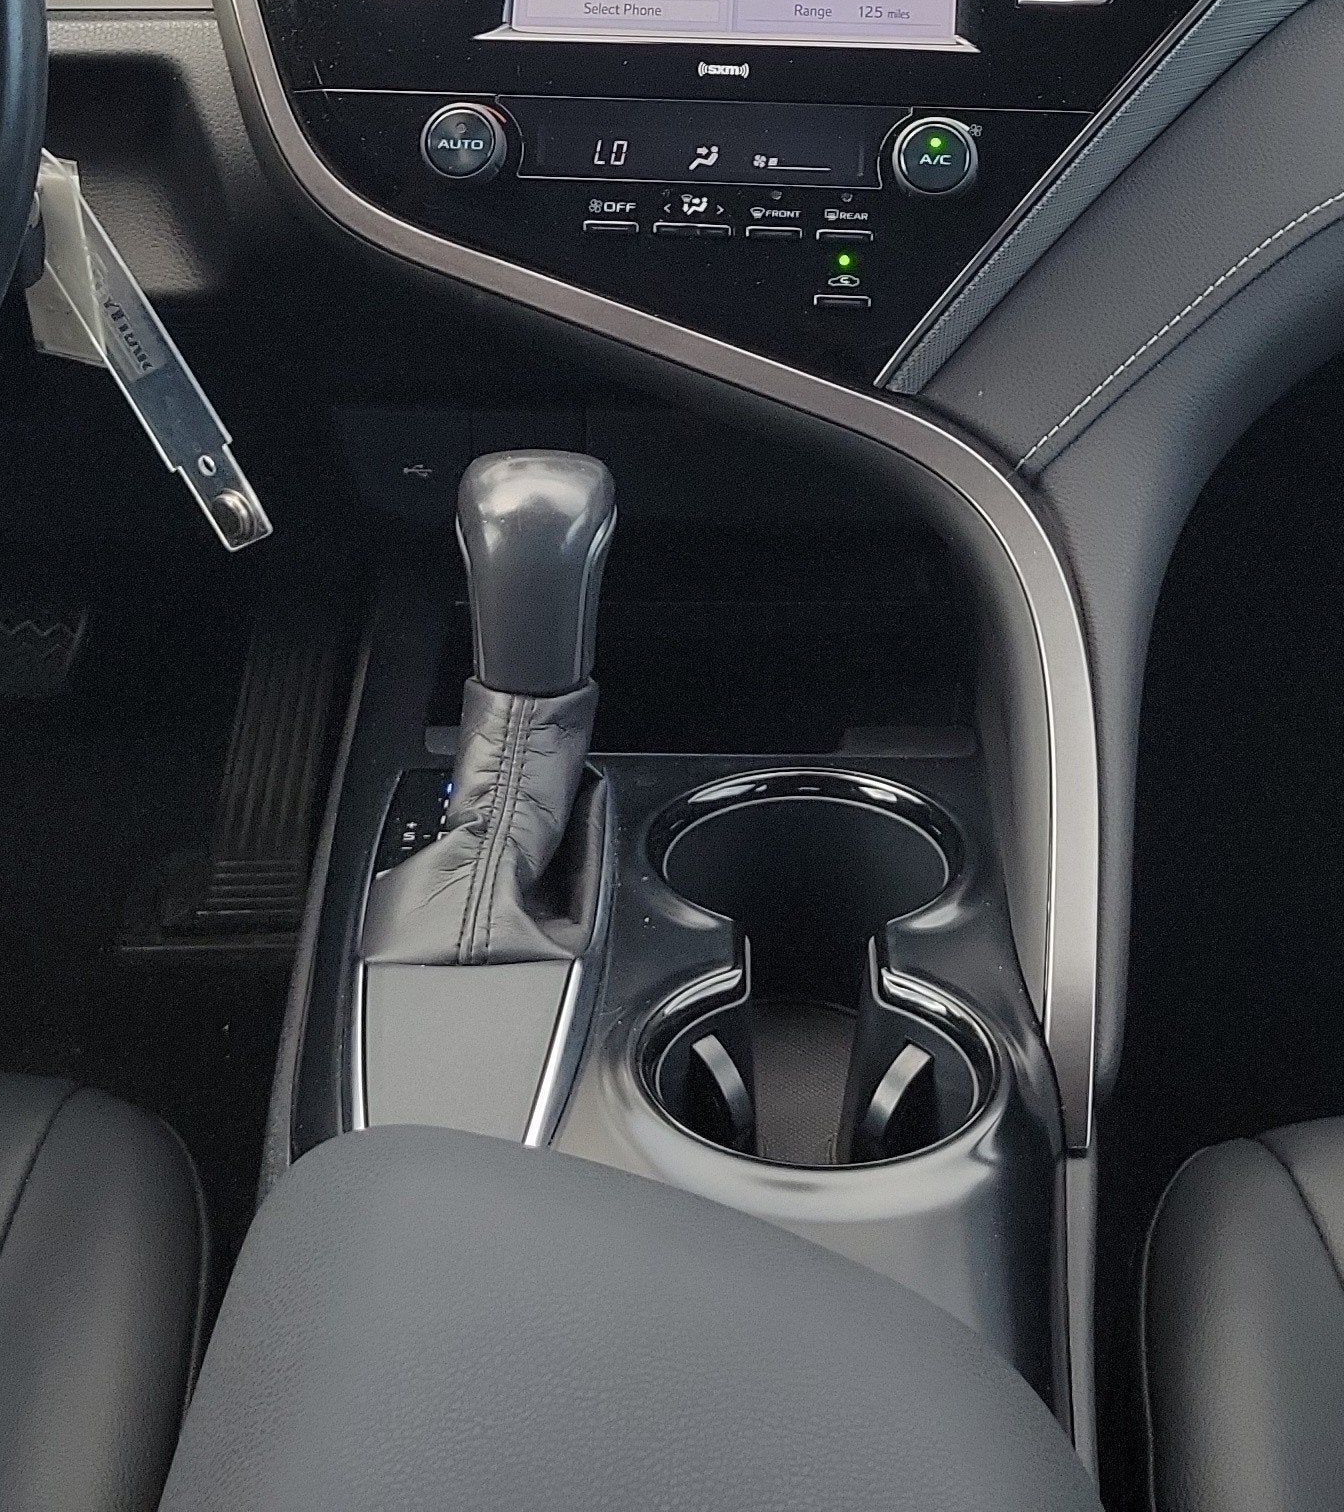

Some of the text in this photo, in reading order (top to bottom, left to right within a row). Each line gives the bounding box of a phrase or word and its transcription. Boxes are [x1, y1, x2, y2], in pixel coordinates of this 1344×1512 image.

[583, 2, 662, 17] Select Phone
[794, 4, 911, 20] Range 125 miles
[437, 139, 484, 151] AUTO
[919, 154, 952, 166] A/C
[603, 202, 637, 213] OFF
[766, 209, 801, 218] FRONT
[839, 212, 869, 221] REAR
[402, 832, 416, 841] S
